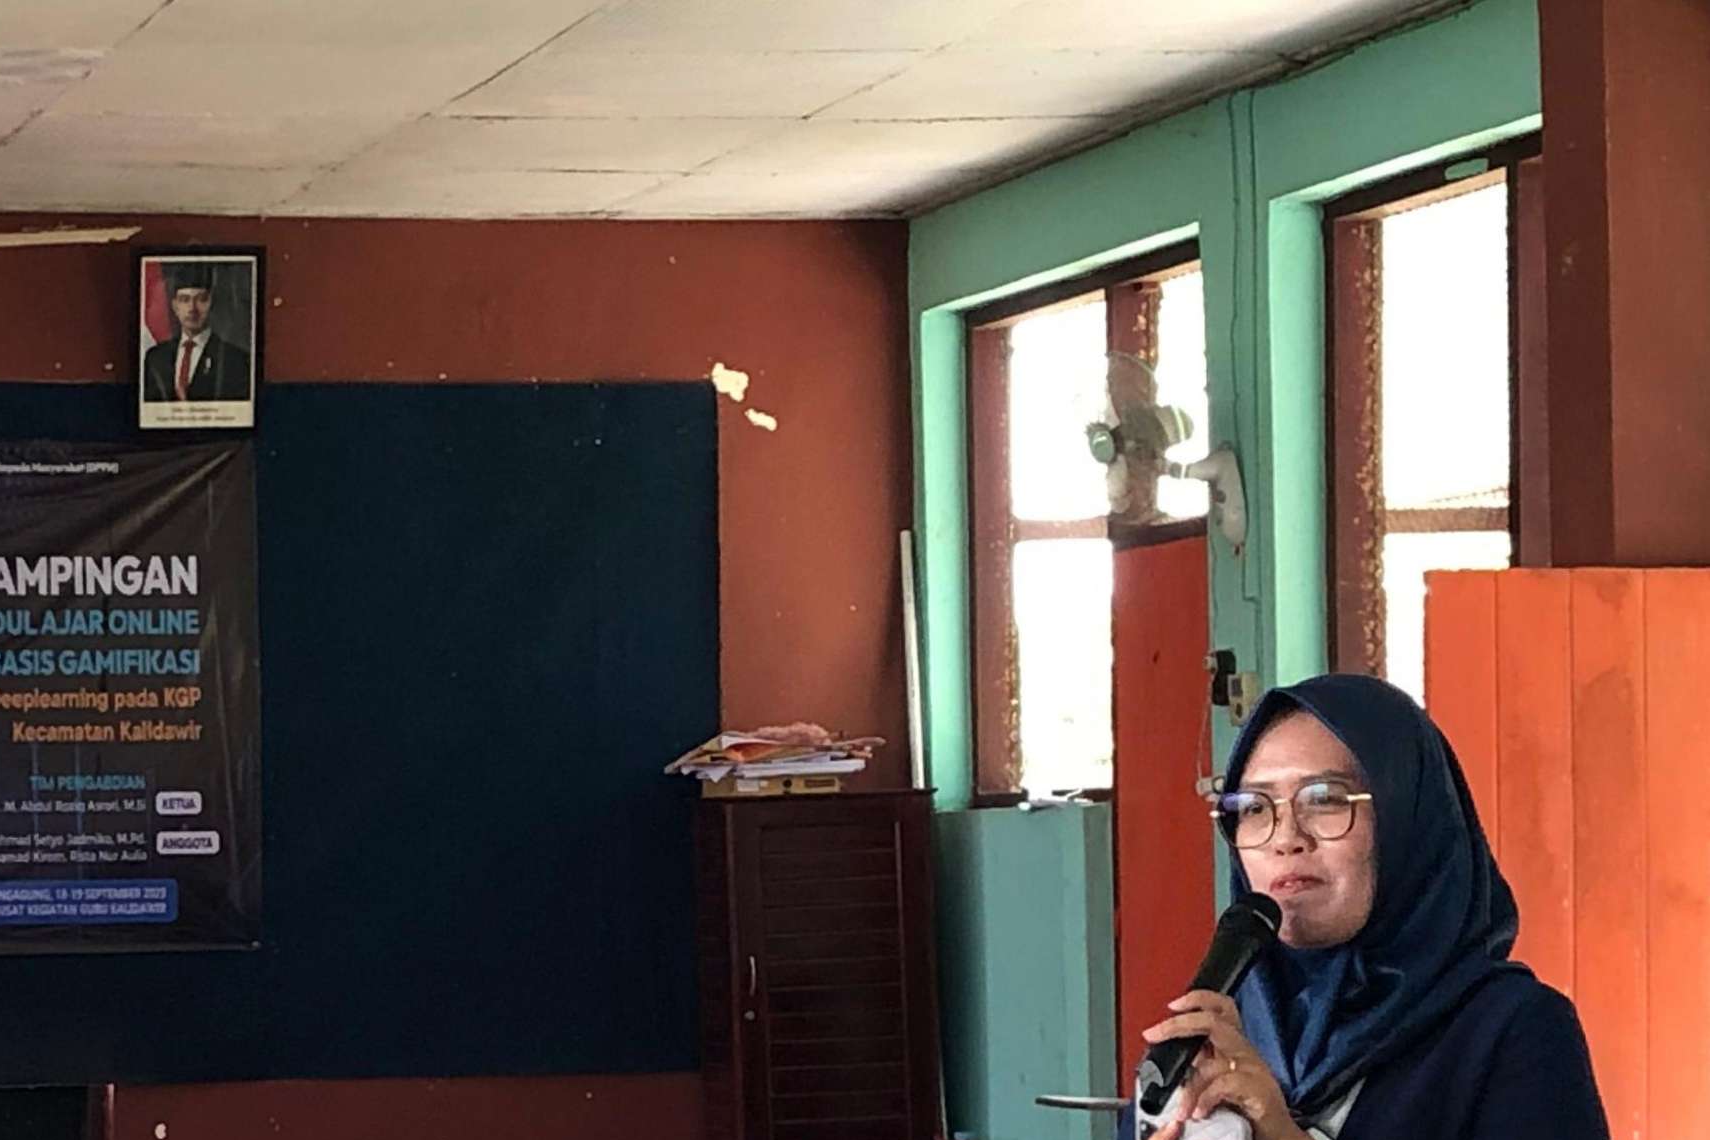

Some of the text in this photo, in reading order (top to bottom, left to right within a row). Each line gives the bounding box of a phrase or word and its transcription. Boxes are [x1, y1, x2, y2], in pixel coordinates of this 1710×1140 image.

[42, 609, 105, 636] AJAR
[107, 608, 200, 635] ONLINE
[58, 649, 201, 676] GAMIFIKASI
[113, 688, 158, 711] pada
[163, 686, 202, 708] KGP
[12, 719, 203, 743] Kecamatan Kalidawir
[28, 774, 147, 791] TIM PENGABDIAN
[161, 797, 197, 811] KETUA
[162, 836, 213, 851] ANGGOTA
